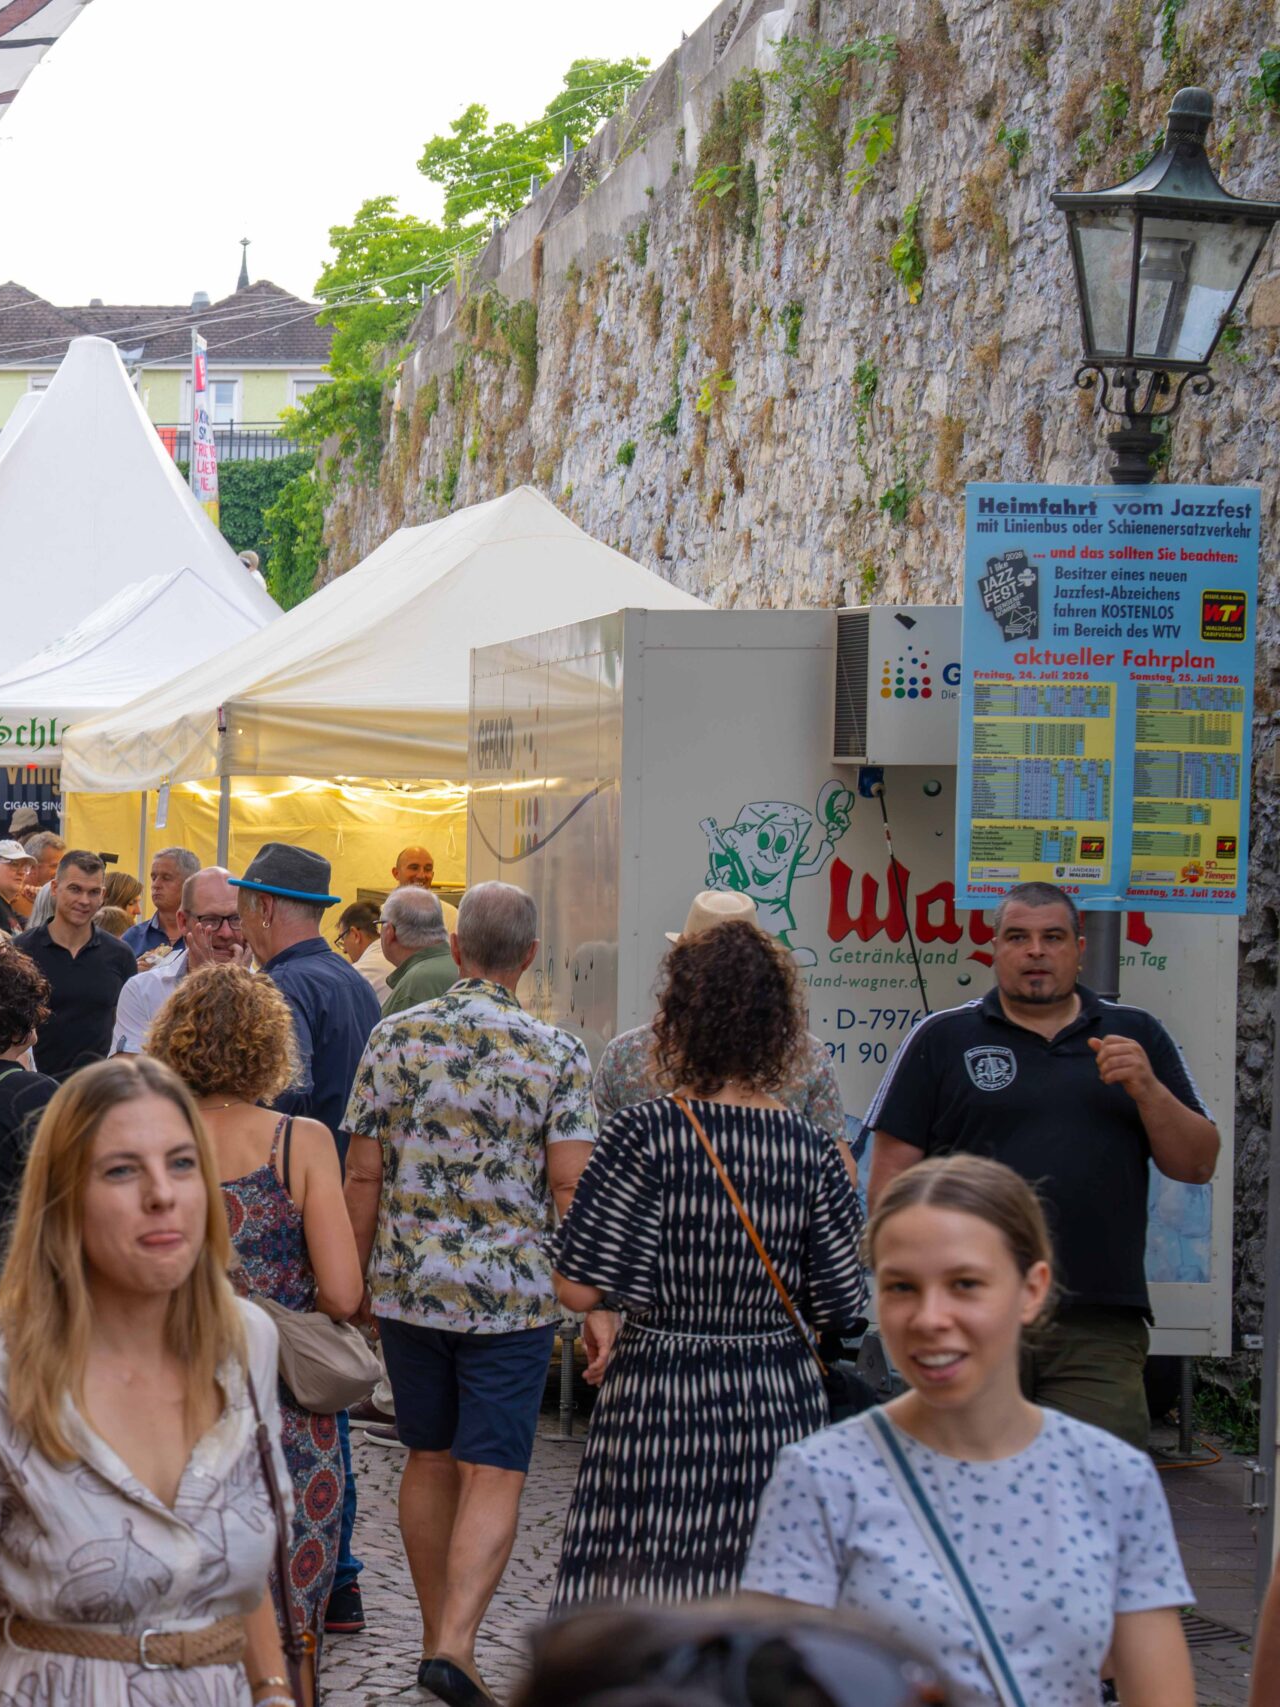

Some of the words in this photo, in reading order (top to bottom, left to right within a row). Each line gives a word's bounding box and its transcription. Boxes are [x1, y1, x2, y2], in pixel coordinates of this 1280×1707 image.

[978, 497, 1097, 515] Heimfahrt
[1113, 502, 1163, 515] vom
[1170, 498, 1252, 519] Jazzfest
[977, 518, 999, 533] mit
[1004, 518, 1068, 533] Linienbus
[1072, 519, 1103, 534] oder
[1108, 519, 1252, 538] Schienenersatzverkehr
[1050, 545, 1076, 559] und
[1080, 545, 1104, 559] das
[1109, 546, 1154, 560] sollten
[1157, 547, 1176, 561] Sie
[1180, 547, 1238, 563] beachten:
[983, 567, 1015, 594] JAZZ
[1055, 566, 1107, 580] Besitzer
[1111, 567, 1145, 581] eines
[1149, 571, 1187, 582] neuen
[983, 581, 1017, 608] FEST
[1053, 585, 1180, 601] Jazzfest-Abzeichens
[1053, 603, 1097, 618] fahren
[1101, 604, 1174, 619] KOSTENLOS
[1204, 604, 1245, 623] WTV
[1053, 623, 1069, 637] im
[1074, 623, 1122, 638] Bereich
[1126, 623, 1148, 638] des
[1152, 625, 1181, 639] WTV
[1014, 646, 1115, 666] aktueller
[1123, 648, 1215, 673] Fahrplan
[973, 670, 1015, 681] Freitag,
[1019, 671, 1036, 680] 24.
[1039, 670, 1058, 680] Juli
[1060, 671, 1089, 680] 2026
[1129, 672, 1175, 682] Samstag,
[1178, 673, 1194, 682] 25.
[1196, 673, 1214, 683] Juli
[1216, 675, 1240, 684] 2026
[941, 690, 957, 700] Die
[477, 716, 514, 770] GEFAKO
[3, 801, 40, 811] CIGARS
[966, 885, 1007, 894] Freitag,
[1126, 888, 1168, 898] Samstag,
[1172, 889, 1187, 897] 25.
[1190, 889, 1208, 897] Juli
[1212, 890, 1237, 899] 2026
[829, 947, 958, 965] Getränkeland
[1140, 951, 1168, 971] Tag
[859, 1042, 887, 1064] 90
